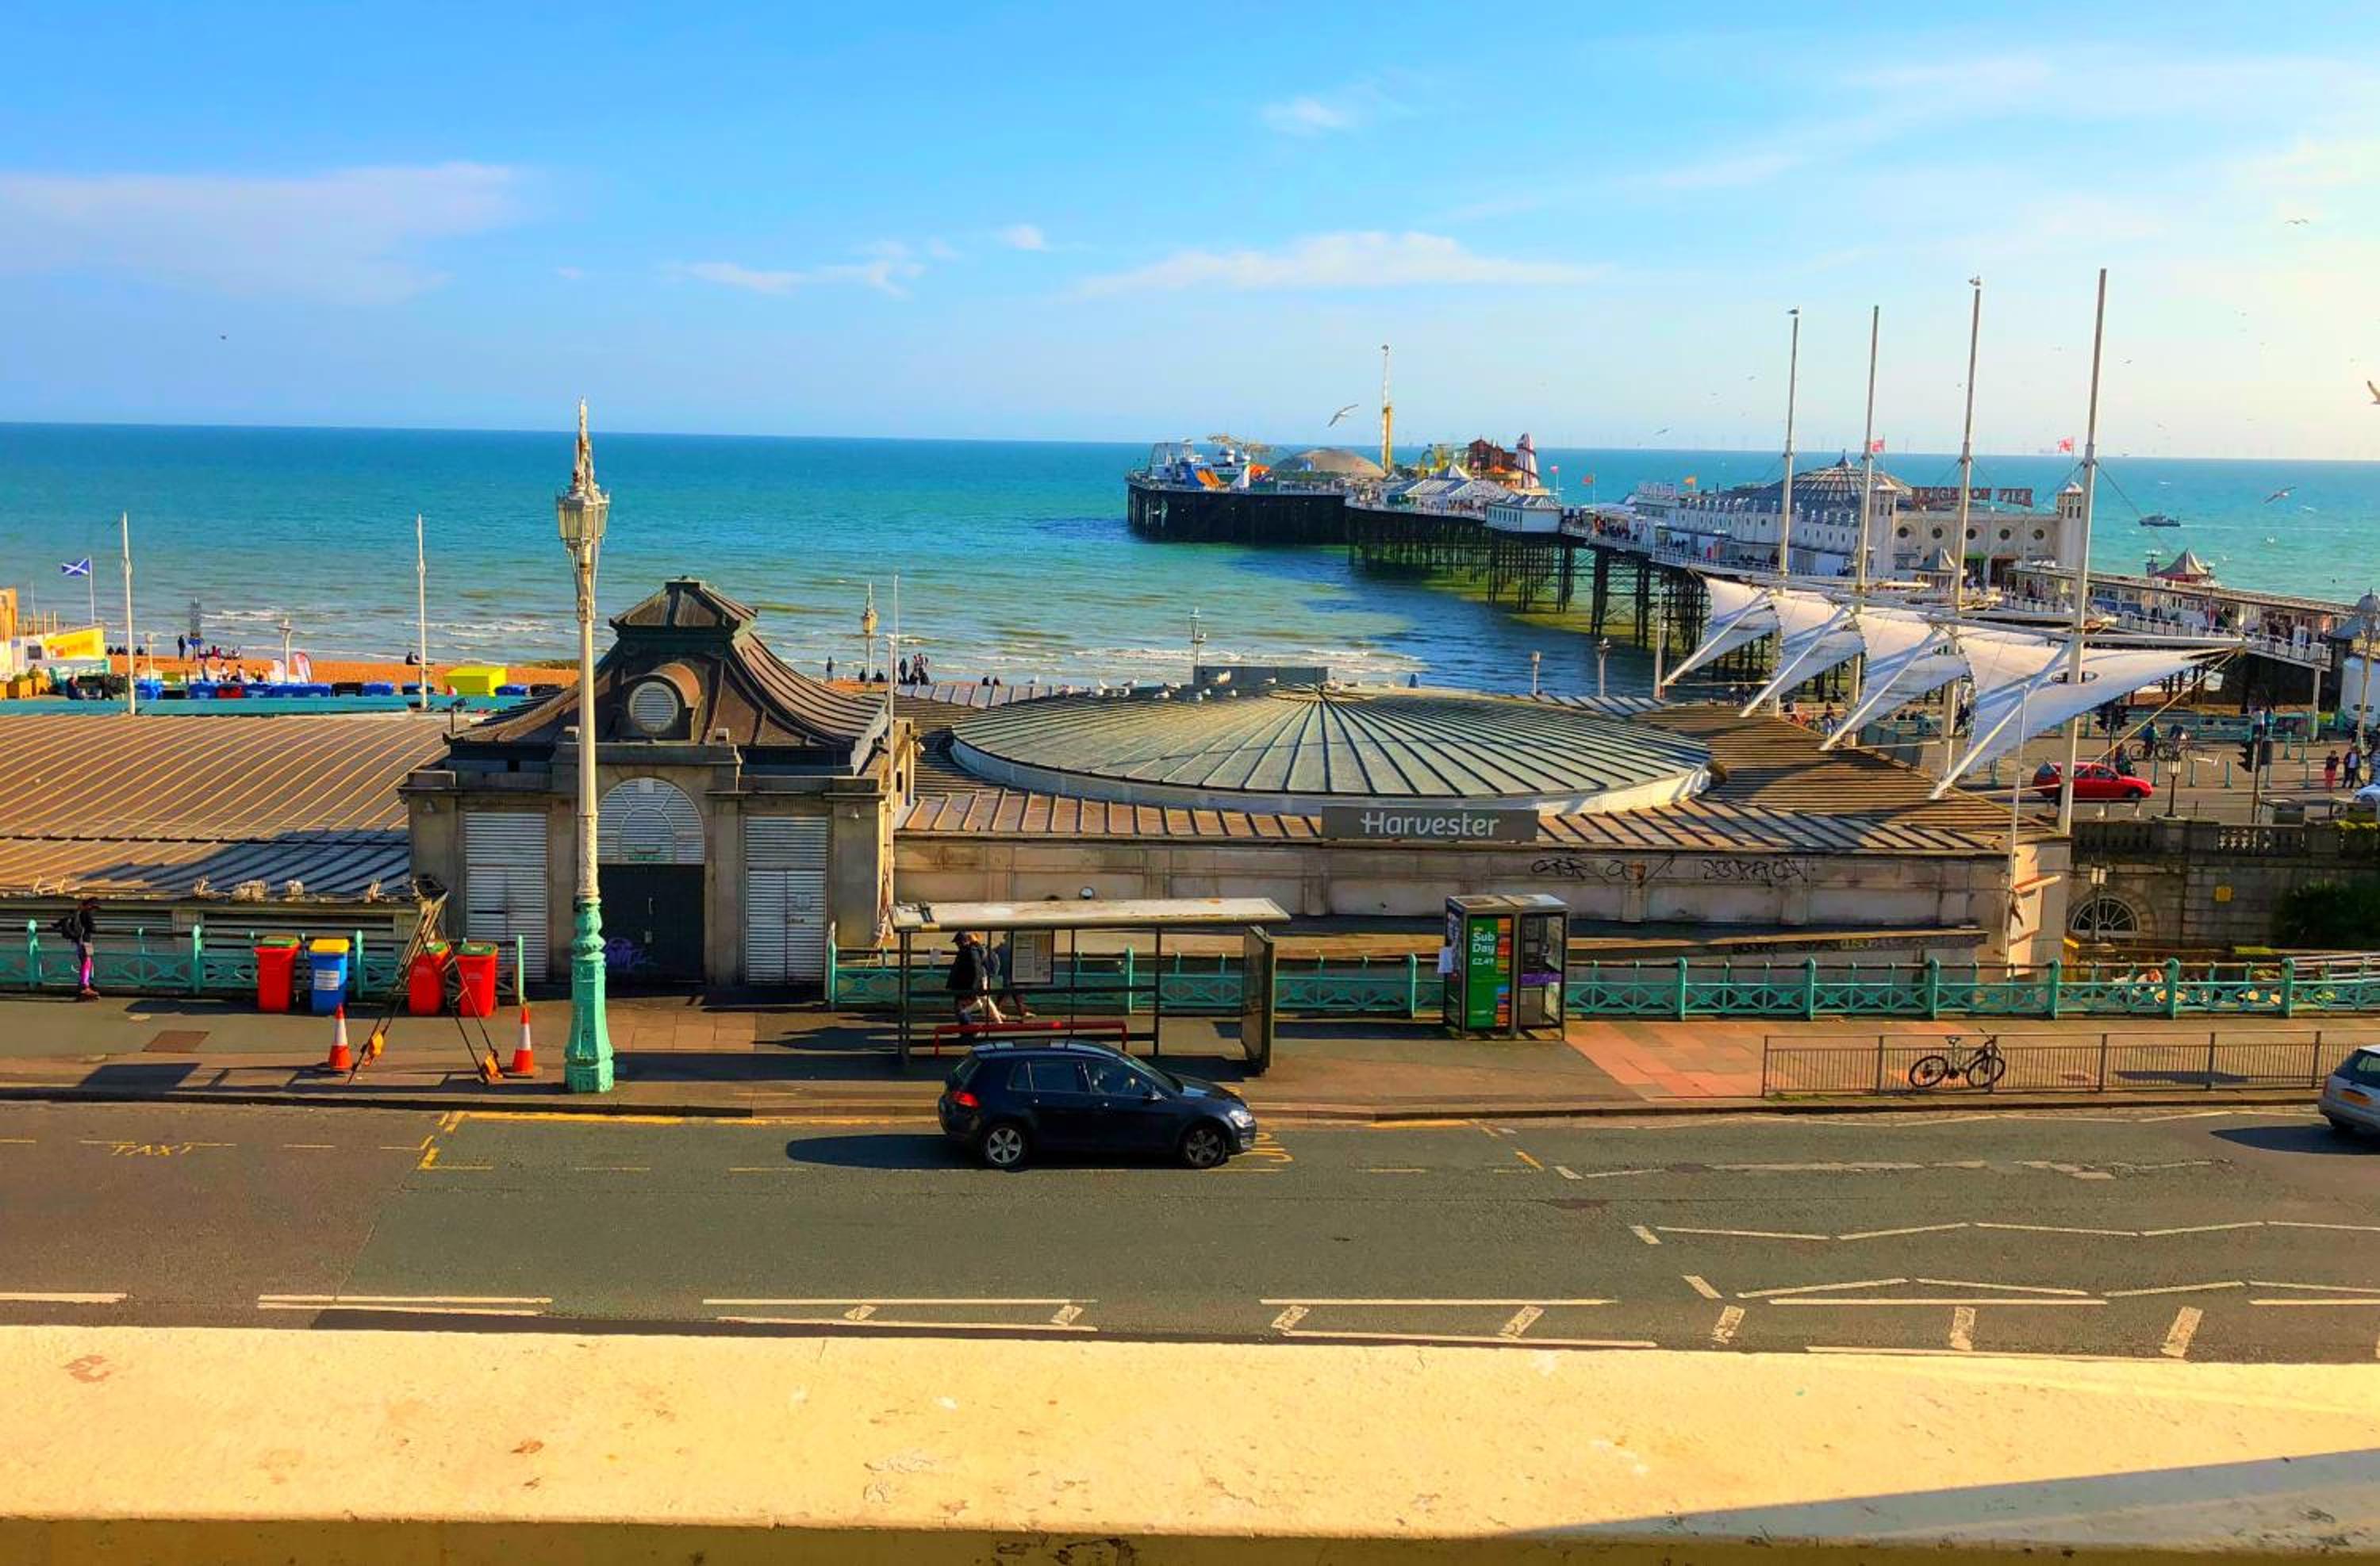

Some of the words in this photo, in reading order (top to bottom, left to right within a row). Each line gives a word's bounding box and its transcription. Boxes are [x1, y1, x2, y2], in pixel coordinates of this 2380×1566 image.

[1361, 812, 1500, 836] Harvester
[1472, 931, 1495, 942] Sub
[1472, 942, 1495, 955] Day
